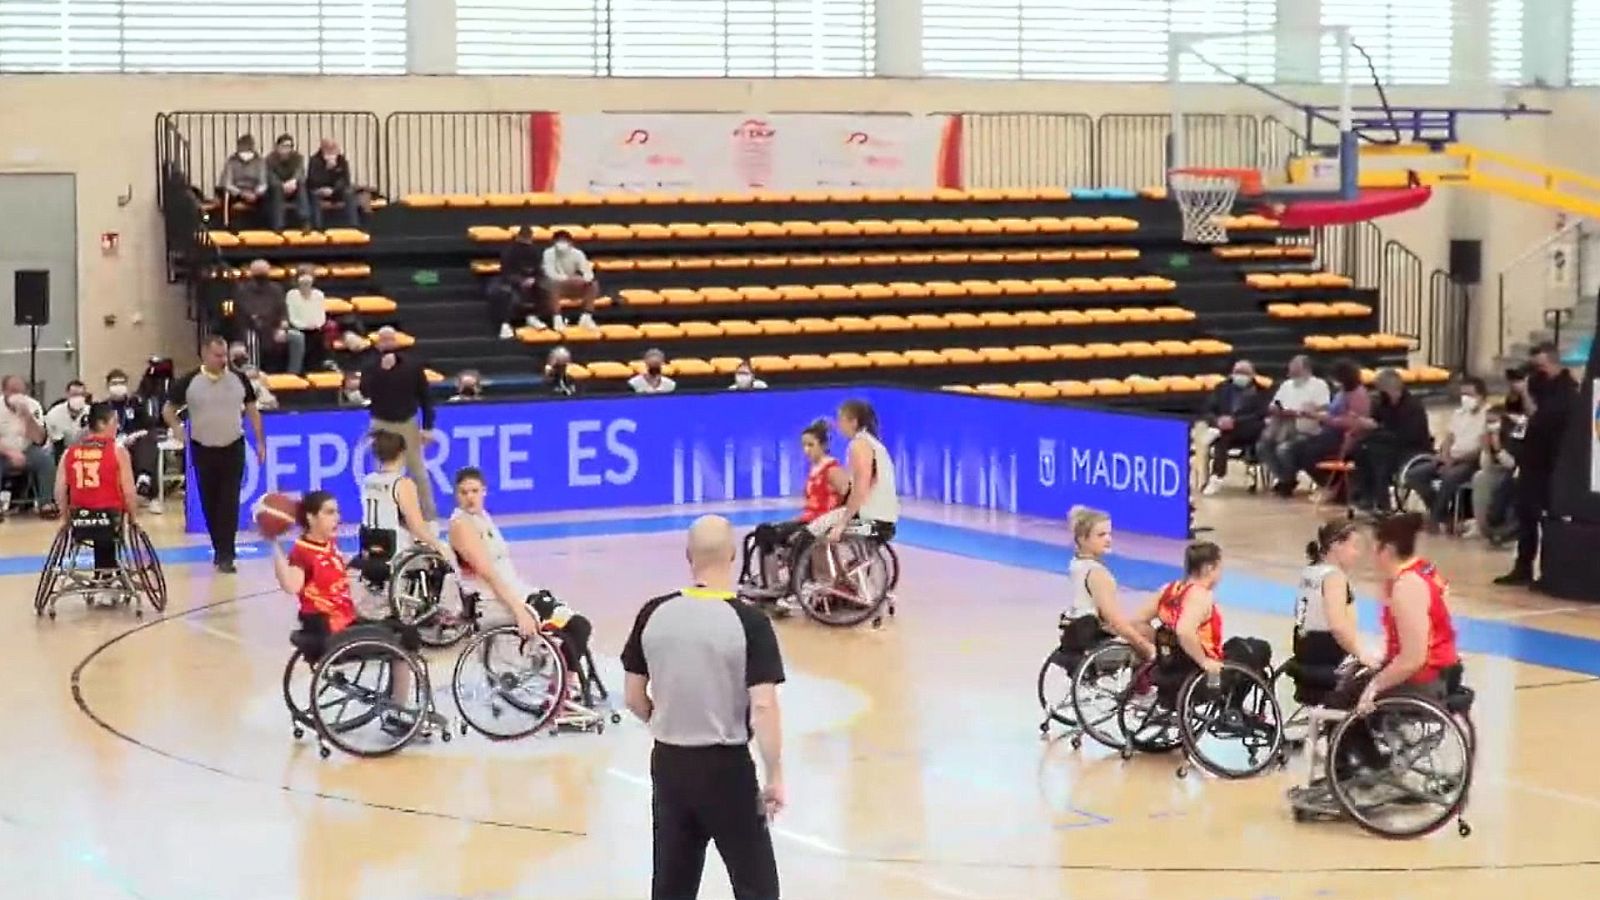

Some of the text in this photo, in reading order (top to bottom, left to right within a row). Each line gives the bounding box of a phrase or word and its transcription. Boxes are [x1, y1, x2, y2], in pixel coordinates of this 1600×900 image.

[568, 418, 639, 486] ES
[1071, 446, 1180, 497] MADRID
[72, 460, 101, 489] 13
[366, 498, 379, 529] 11
